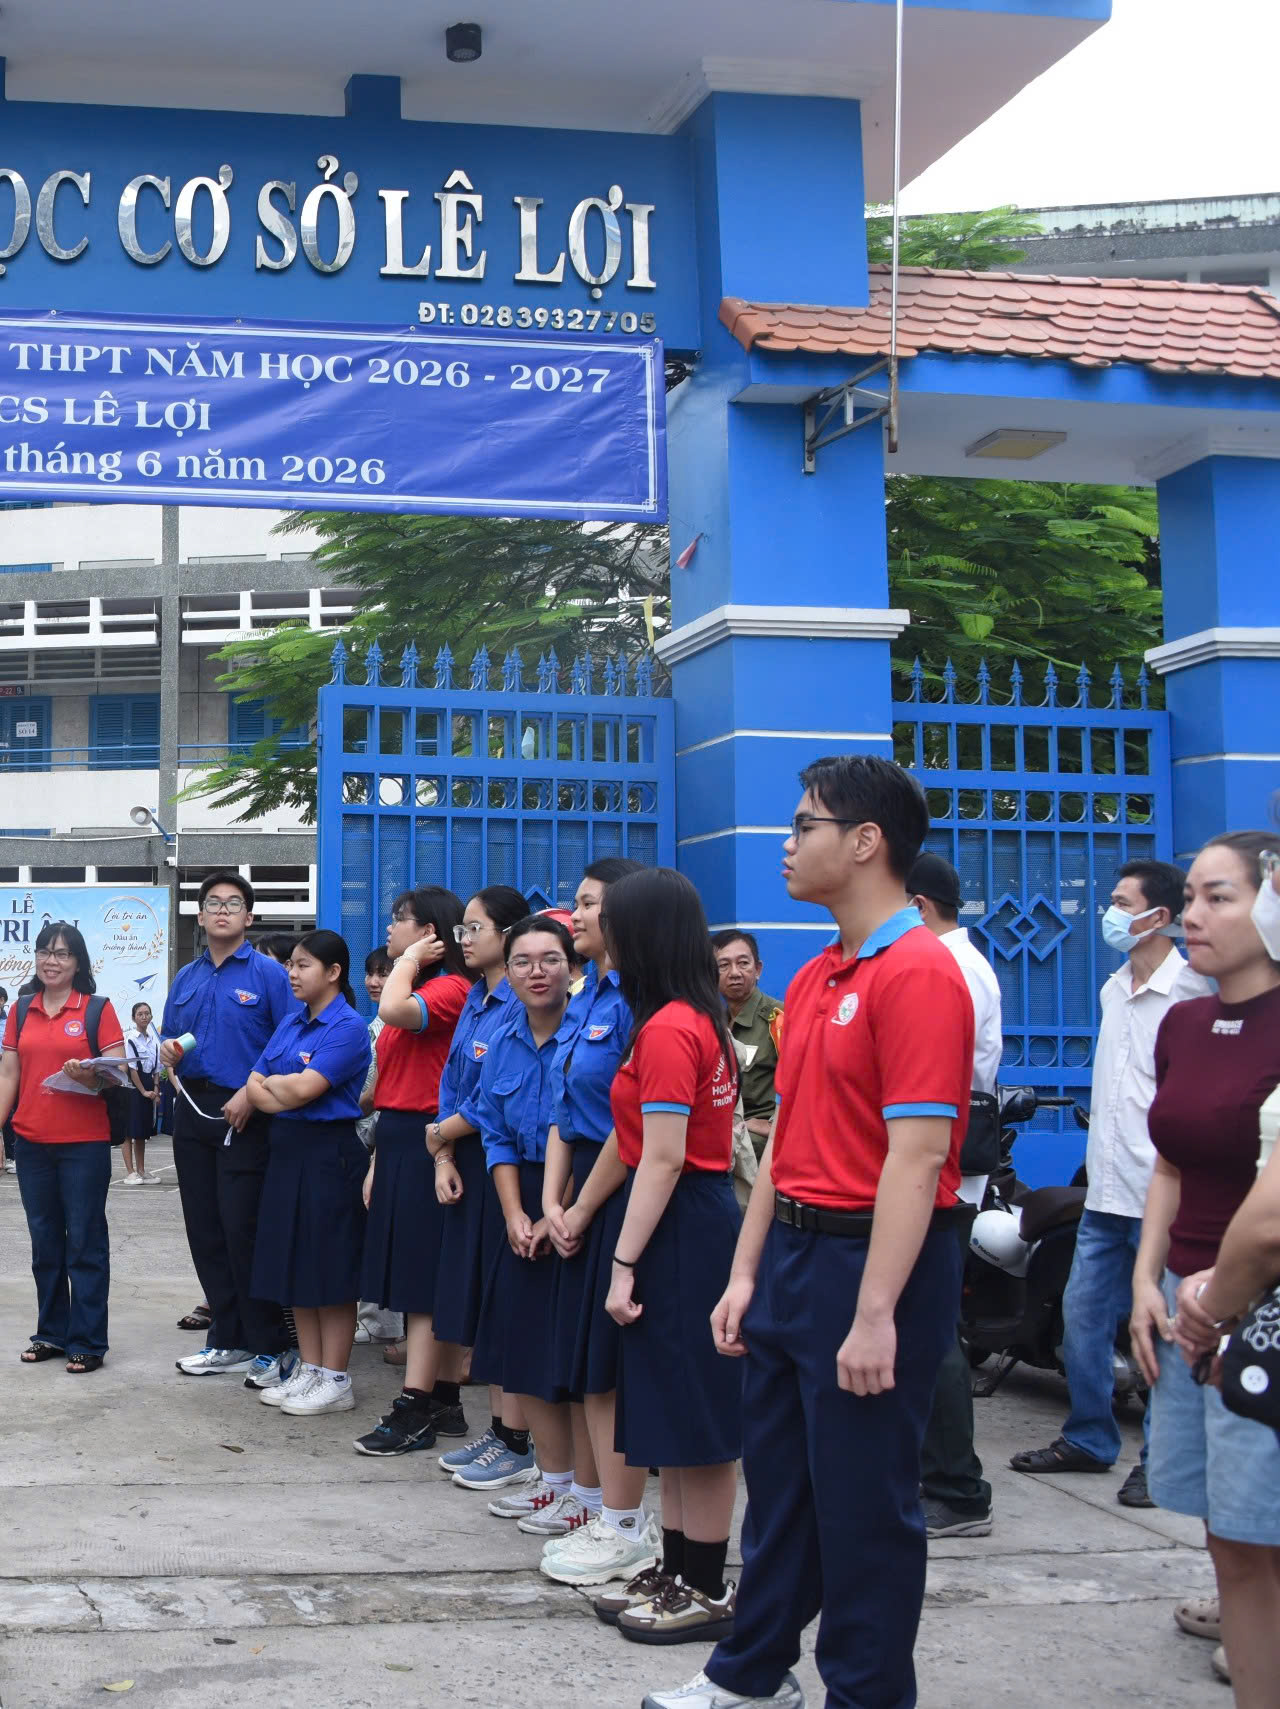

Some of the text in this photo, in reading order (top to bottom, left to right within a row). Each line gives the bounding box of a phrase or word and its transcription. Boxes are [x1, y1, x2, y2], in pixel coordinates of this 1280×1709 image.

[117, 164, 234, 266] CƠ
[255, 154, 359, 273] SỞ
[378, 169, 487, 279] LÊ
[513, 184, 657, 299] LỢI
[418, 301, 657, 334] ĐT: 02839327705
[8, 342, 132, 374] THPT
[143, 341, 246, 379] NĂM
[258, 352, 353, 389] HỌC
[367, 357, 471, 388] 2026
[483, 374, 497, 382] -
[509, 364, 612, 393] 2027
[63, 390, 122, 427] LÊ
[135, 398, 211, 438] LỢI
[3, 441, 123, 483] tháng
[136, 450, 163, 478] 6
[175, 448, 267, 481] năm
[281, 455, 386, 485] 2026
[11, 893, 35, 914] LỄ
[122, 911, 133, 920] tri
[136, 912, 147, 920] ân
[22, 945, 31, 954] &
